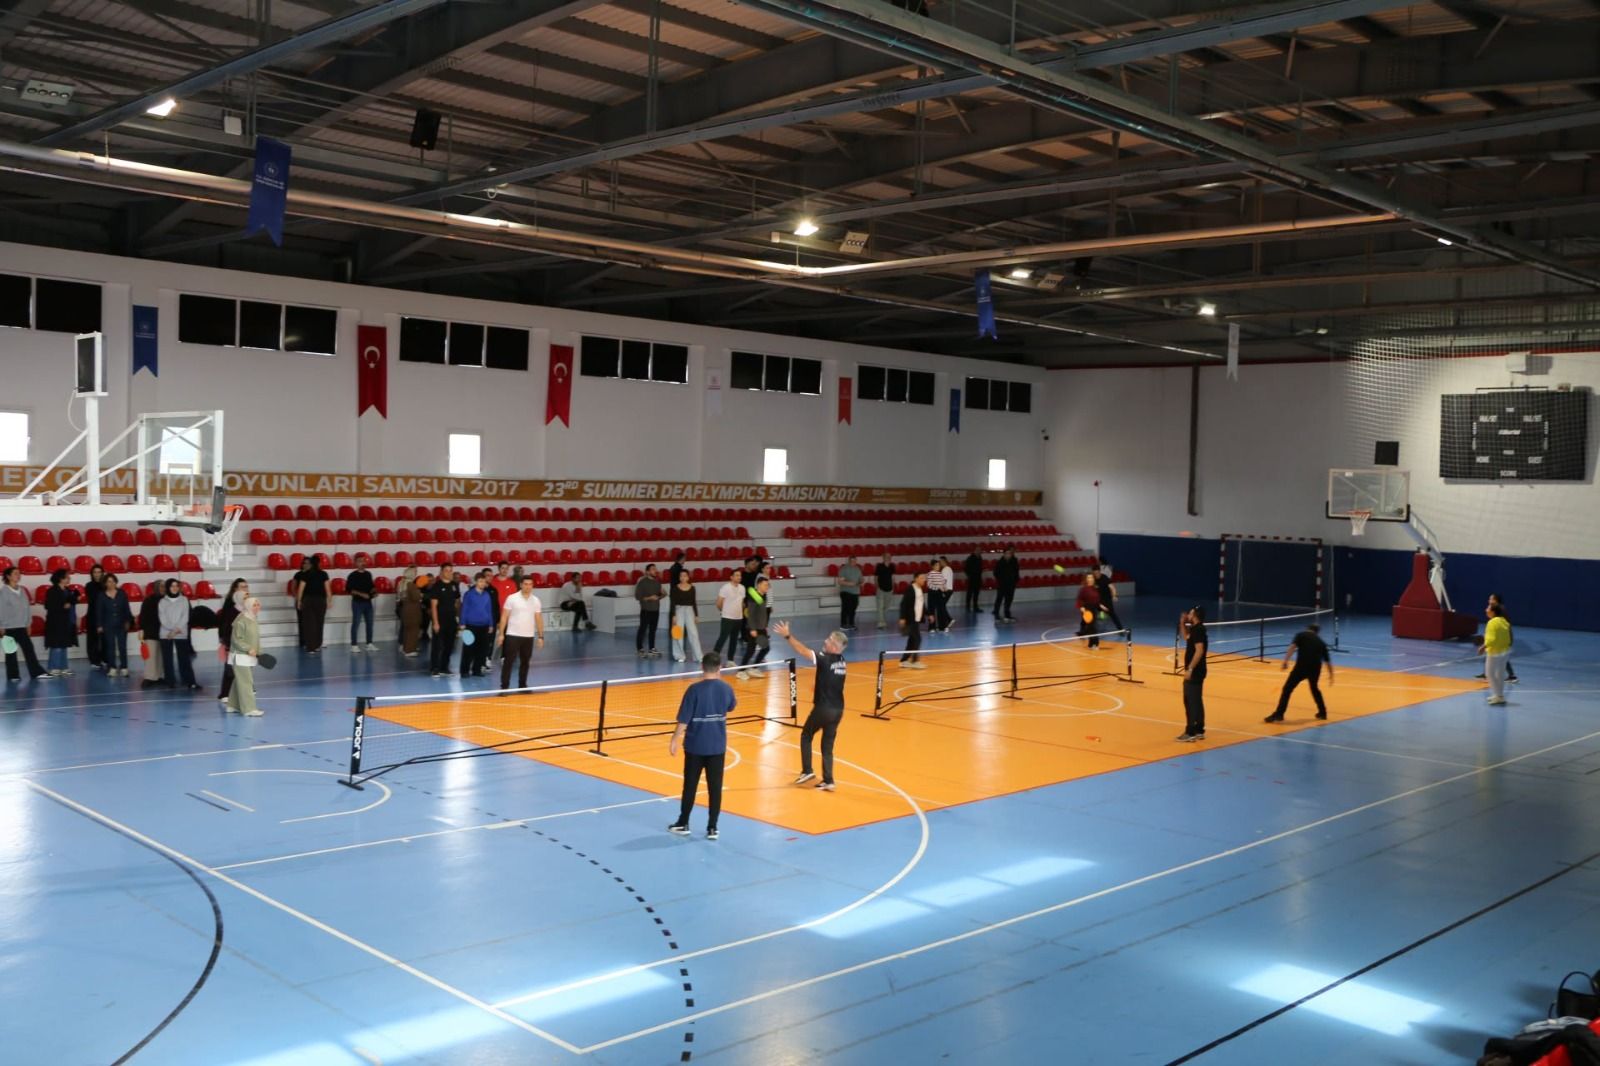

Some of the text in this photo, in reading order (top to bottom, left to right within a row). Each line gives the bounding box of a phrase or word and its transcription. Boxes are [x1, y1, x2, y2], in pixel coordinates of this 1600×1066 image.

[223, 473, 357, 493] OYUNLARI
[363, 477, 465, 495] SAMSUN
[470, 480, 520, 496] 2017
[581, 482, 658, 498] SUMMER
[660, 484, 766, 500] DEAFLYMPICS
[768, 486, 828, 501] SAMSUN
[829, 488, 861, 501] 2017
[353, 715, 363, 750] JOOLA
